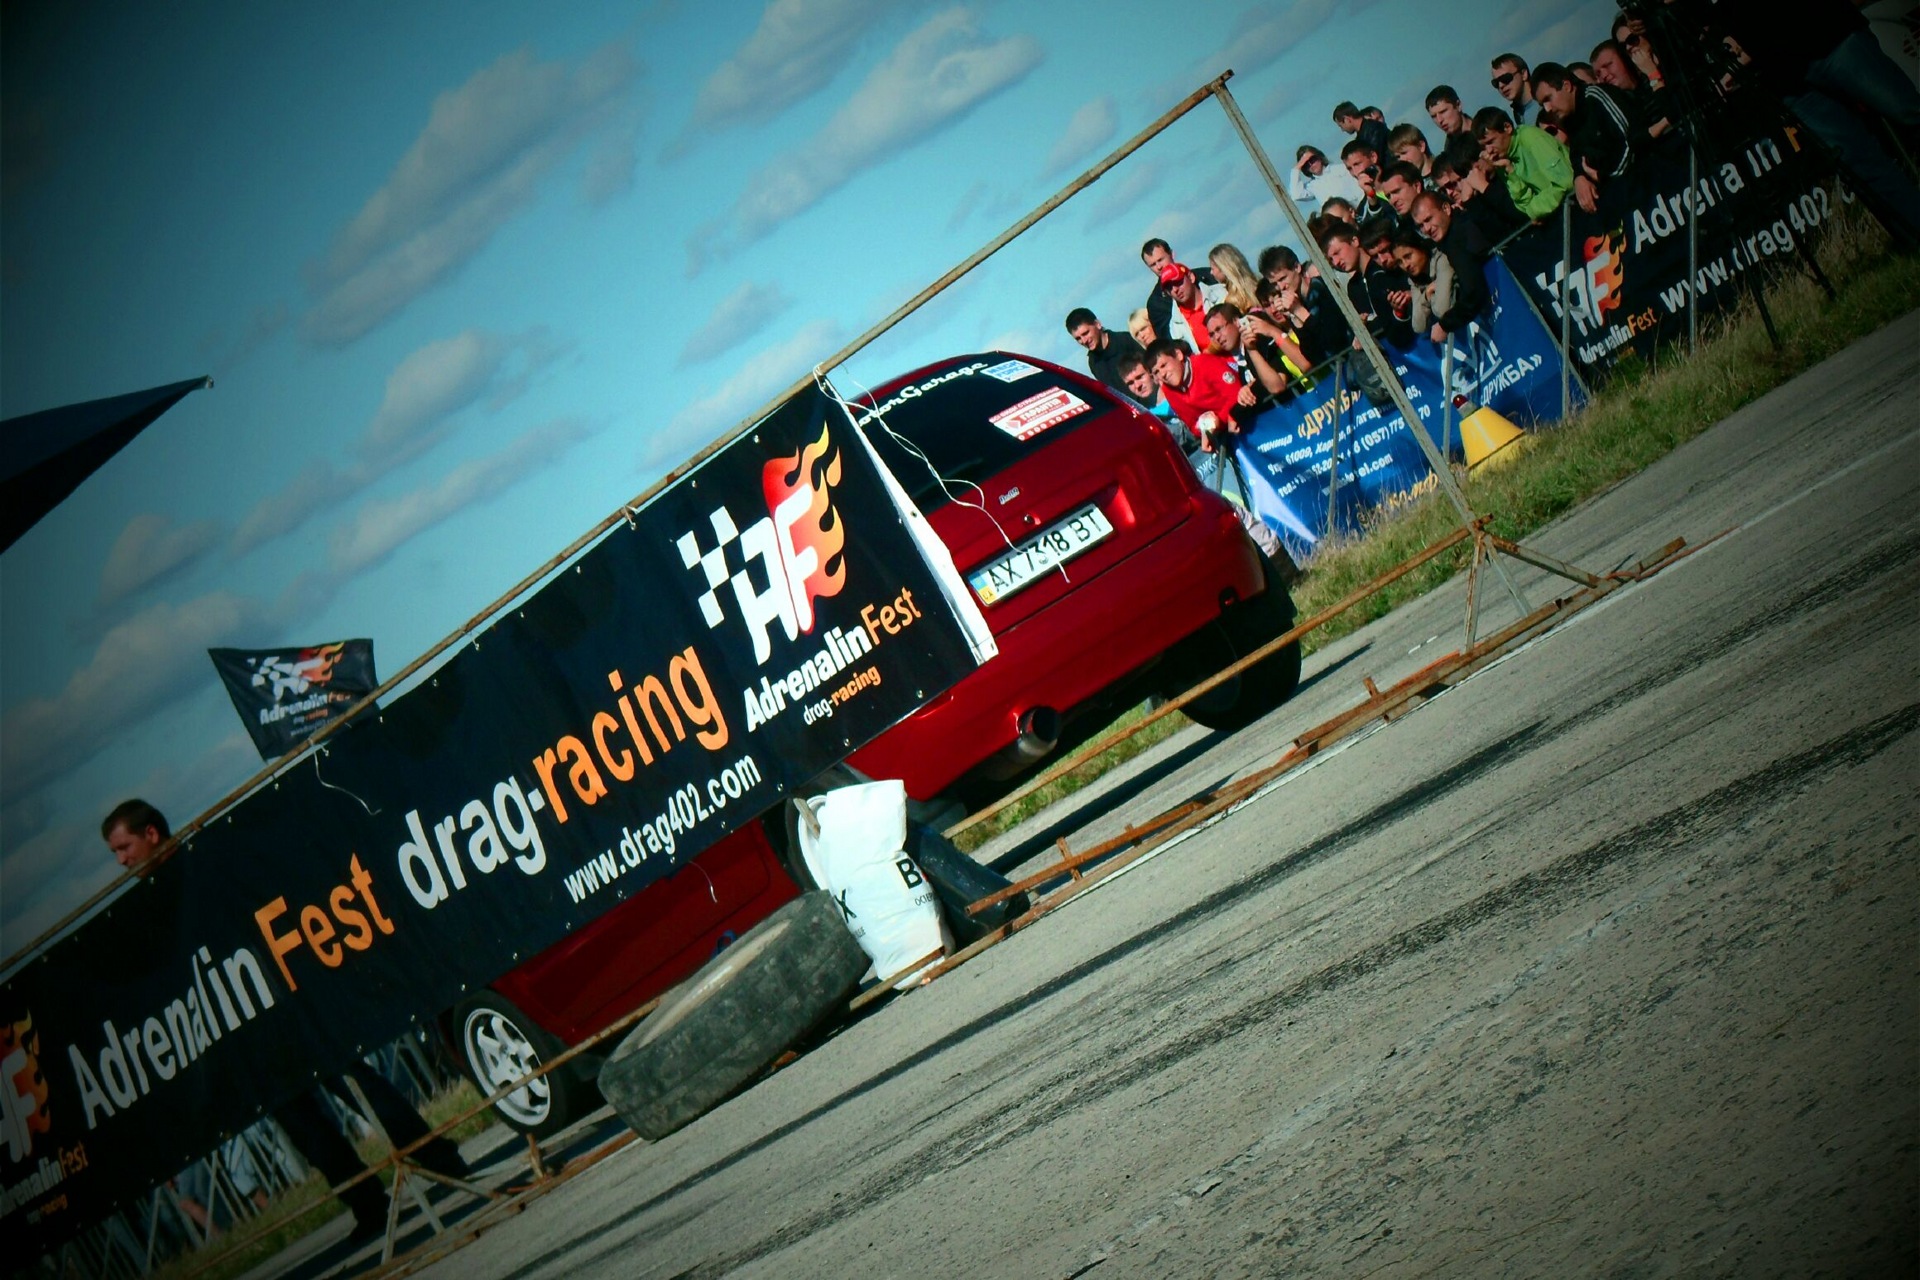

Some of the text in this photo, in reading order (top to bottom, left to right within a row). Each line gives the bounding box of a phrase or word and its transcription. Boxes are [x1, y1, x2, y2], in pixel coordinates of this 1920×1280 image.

[987, 557, 1023, 592] AX
[1068, 508, 1102, 543] BT
[742, 586, 921, 734] AdrenalinFest
[803, 666, 881, 727] drag-racing
[397, 645, 731, 911] drag-racing
[563, 753, 763, 905] www.drag402.com
